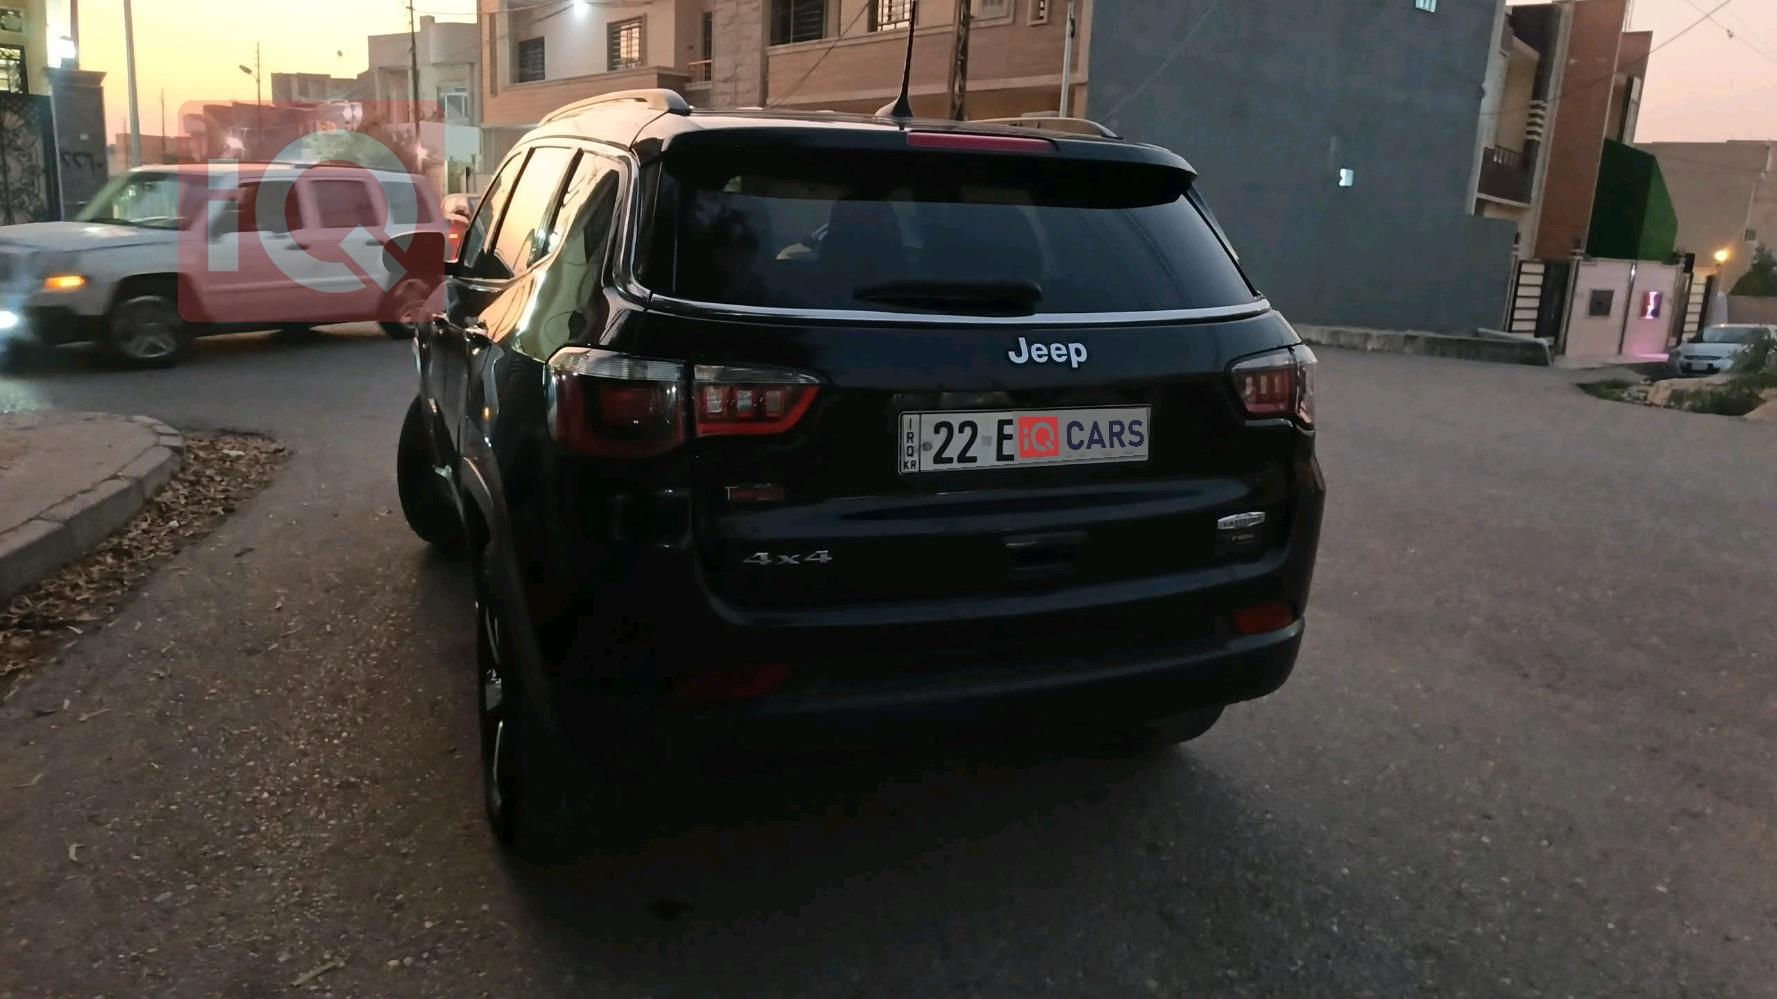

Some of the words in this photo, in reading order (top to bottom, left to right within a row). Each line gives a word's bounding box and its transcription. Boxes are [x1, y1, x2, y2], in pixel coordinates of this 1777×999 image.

[1008, 337, 1088, 368] Jeep
[932, 420, 979, 465] 22
[903, 460, 917, 470] KR
